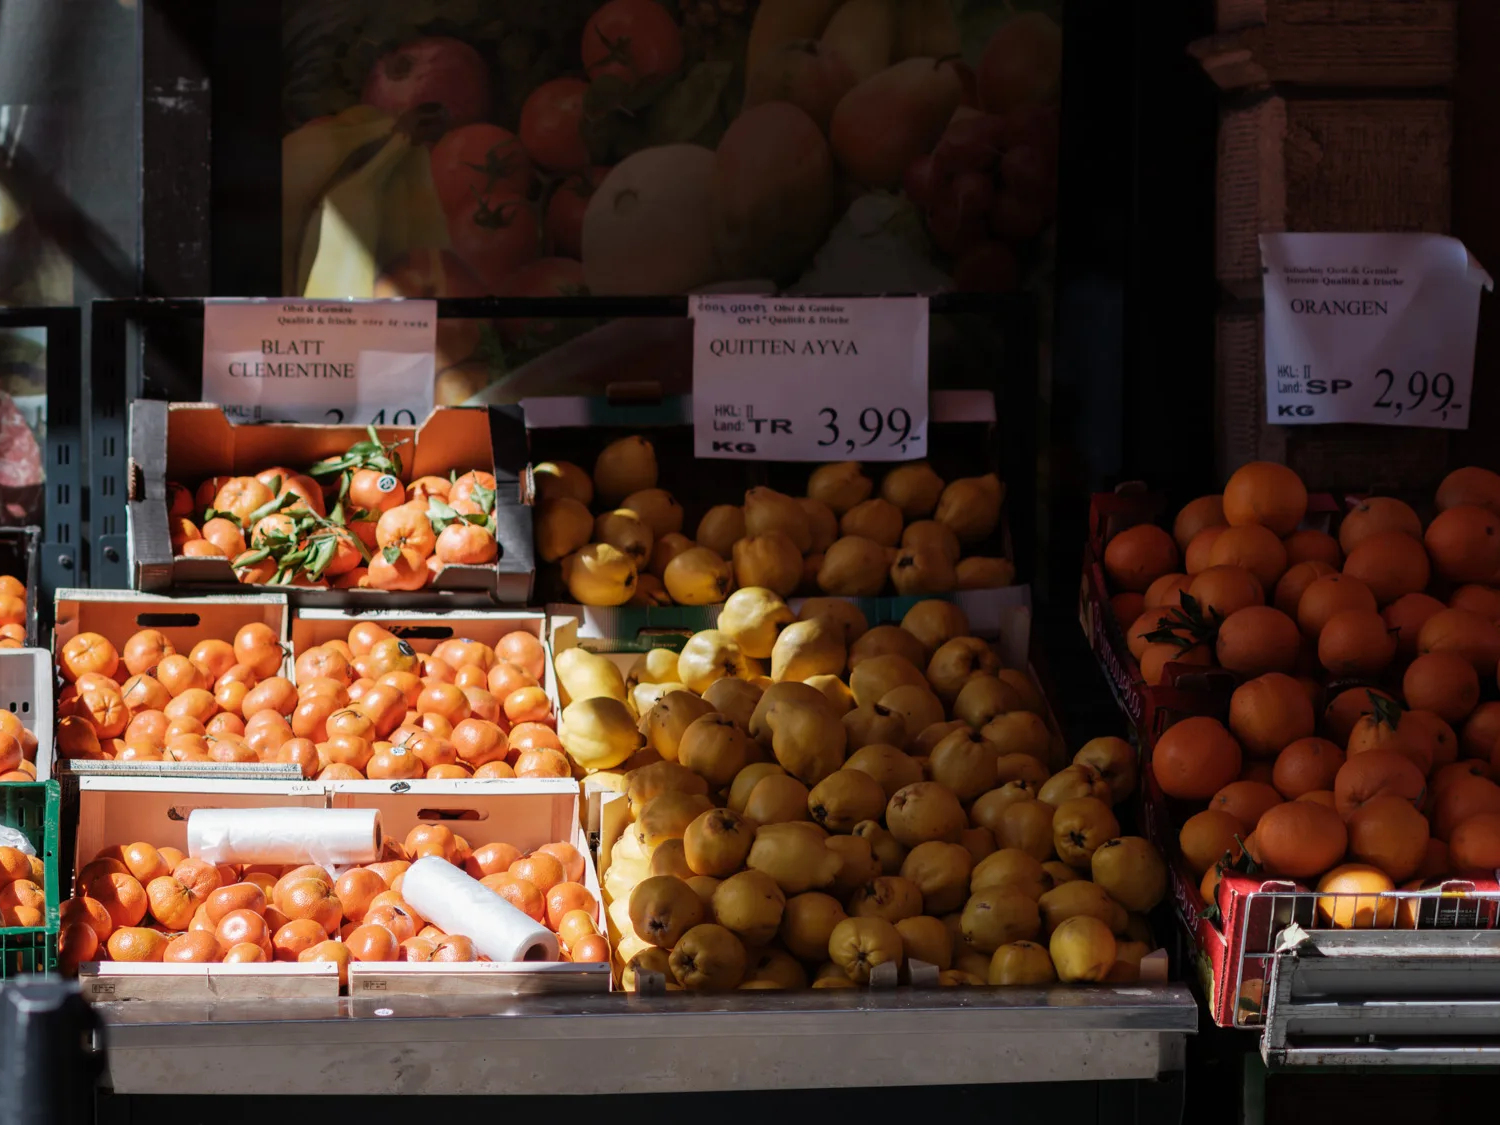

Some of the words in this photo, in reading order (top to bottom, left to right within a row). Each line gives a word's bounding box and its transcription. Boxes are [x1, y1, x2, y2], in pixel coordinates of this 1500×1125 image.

[1290, 298, 1388, 316] ORANGEN
[261, 339, 325, 356] BLATT
[709, 338, 797, 357] QUITTEN
[801, 338, 859, 356] AYVA
[228, 361, 355, 379] CLEMENTINE
[1277, 365, 1300, 379] HKL:
[1277, 380, 1303, 394] Land:
[1306, 379, 1353, 395] SP
[714, 404, 742, 417] HKL:
[1277, 404, 1316, 417] KG
[713, 419, 745, 433] Land:
[748, 418, 793, 434] TR
[712, 441, 757, 454] KG
